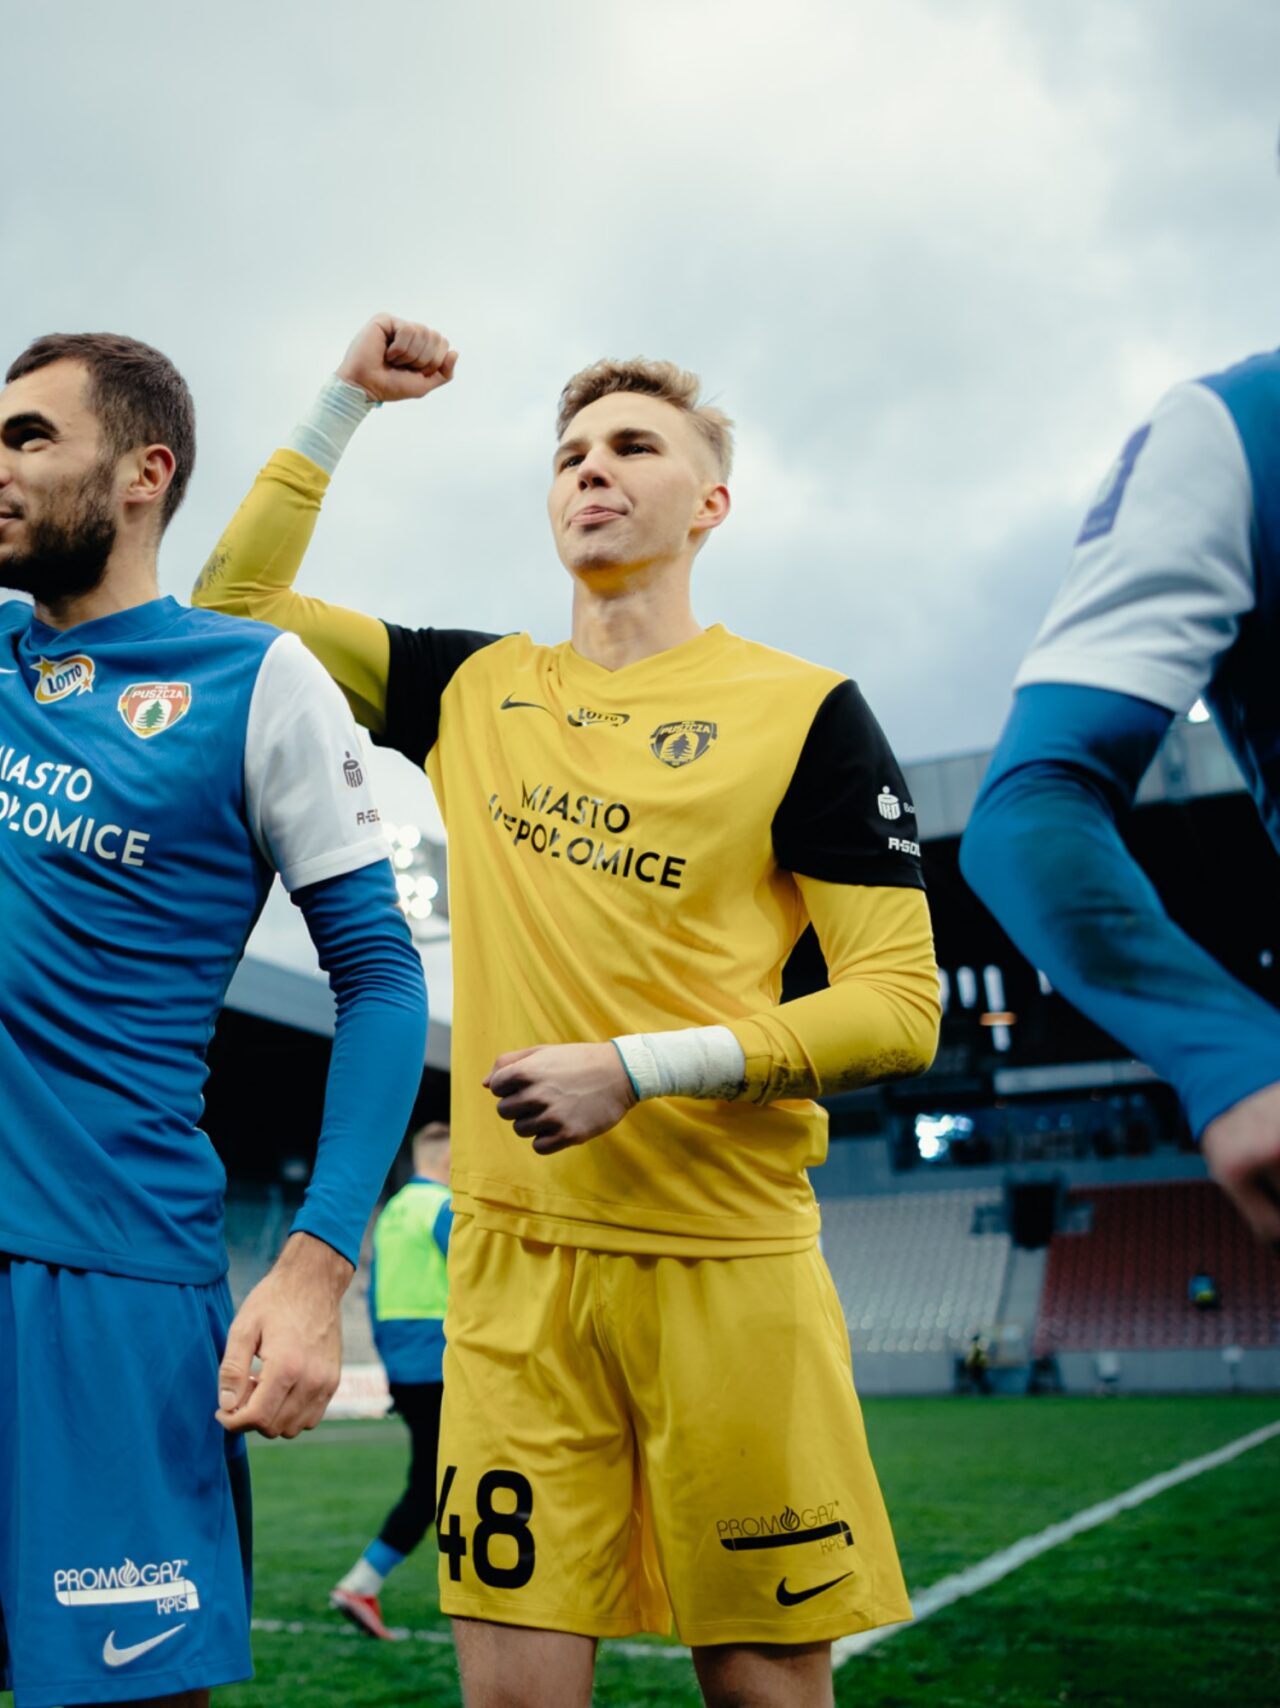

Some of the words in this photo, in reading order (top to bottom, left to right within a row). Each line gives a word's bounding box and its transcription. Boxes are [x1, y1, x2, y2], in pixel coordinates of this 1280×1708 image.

[46, 663, 83, 694] LOTTO
[132, 689, 183, 699] PUSZCZA
[521, 779, 631, 834] MIASTO
[435, 1465, 536, 1590] 48
[54, 1558, 185, 1592] PROMOGAZ
[156, 1596, 188, 1616] KPIS
